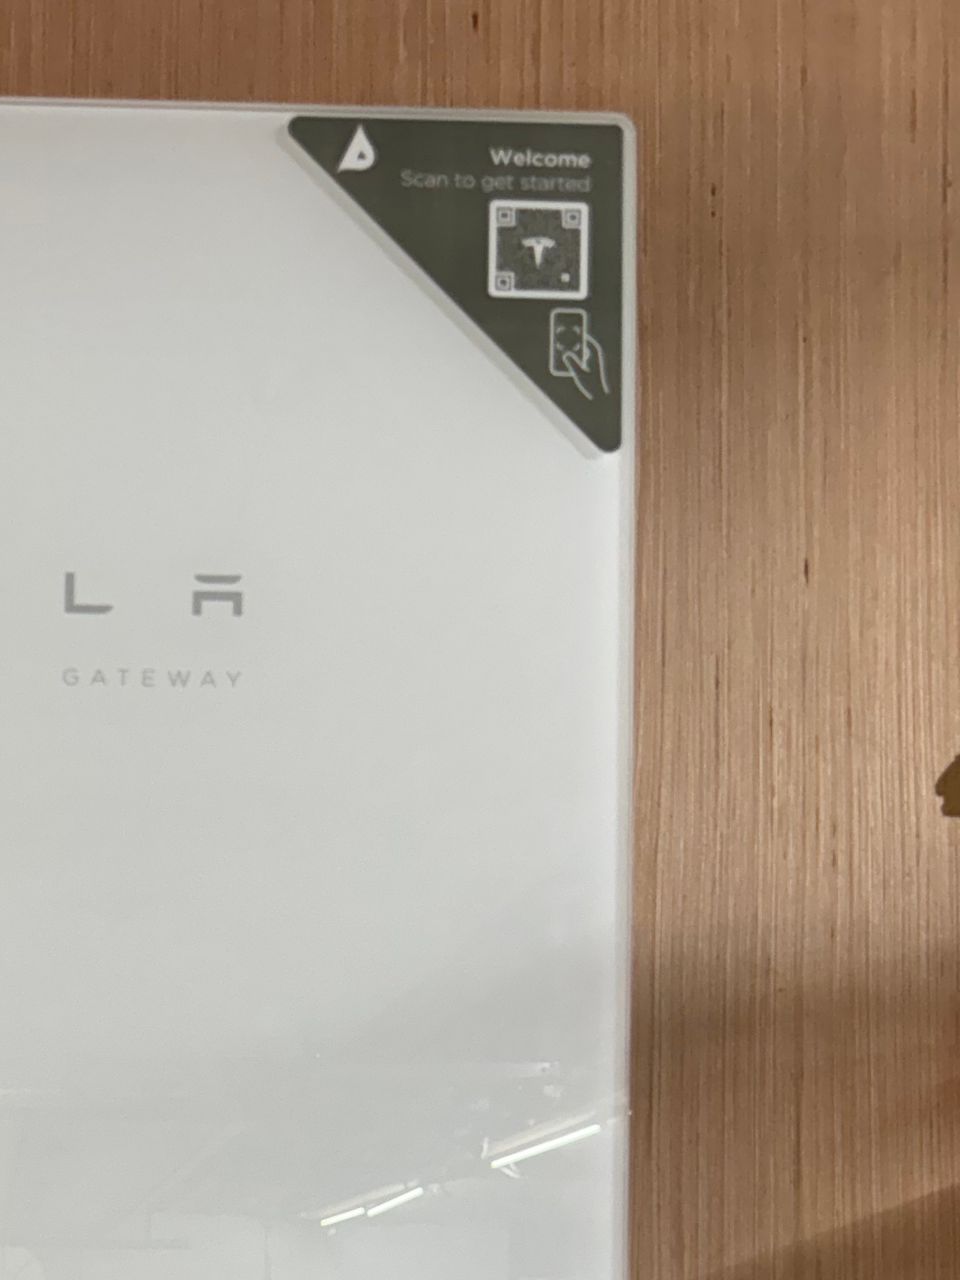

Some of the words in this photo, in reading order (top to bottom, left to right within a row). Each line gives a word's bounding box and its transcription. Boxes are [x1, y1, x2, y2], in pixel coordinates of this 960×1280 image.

[489, 147, 591, 169] Welcome
[400, 169, 449, 189] Scan
[455, 170, 476, 188] to
[481, 174, 514, 194] get
[520, 174, 592, 194] started
[62, 667, 244, 688] GATEWAY
